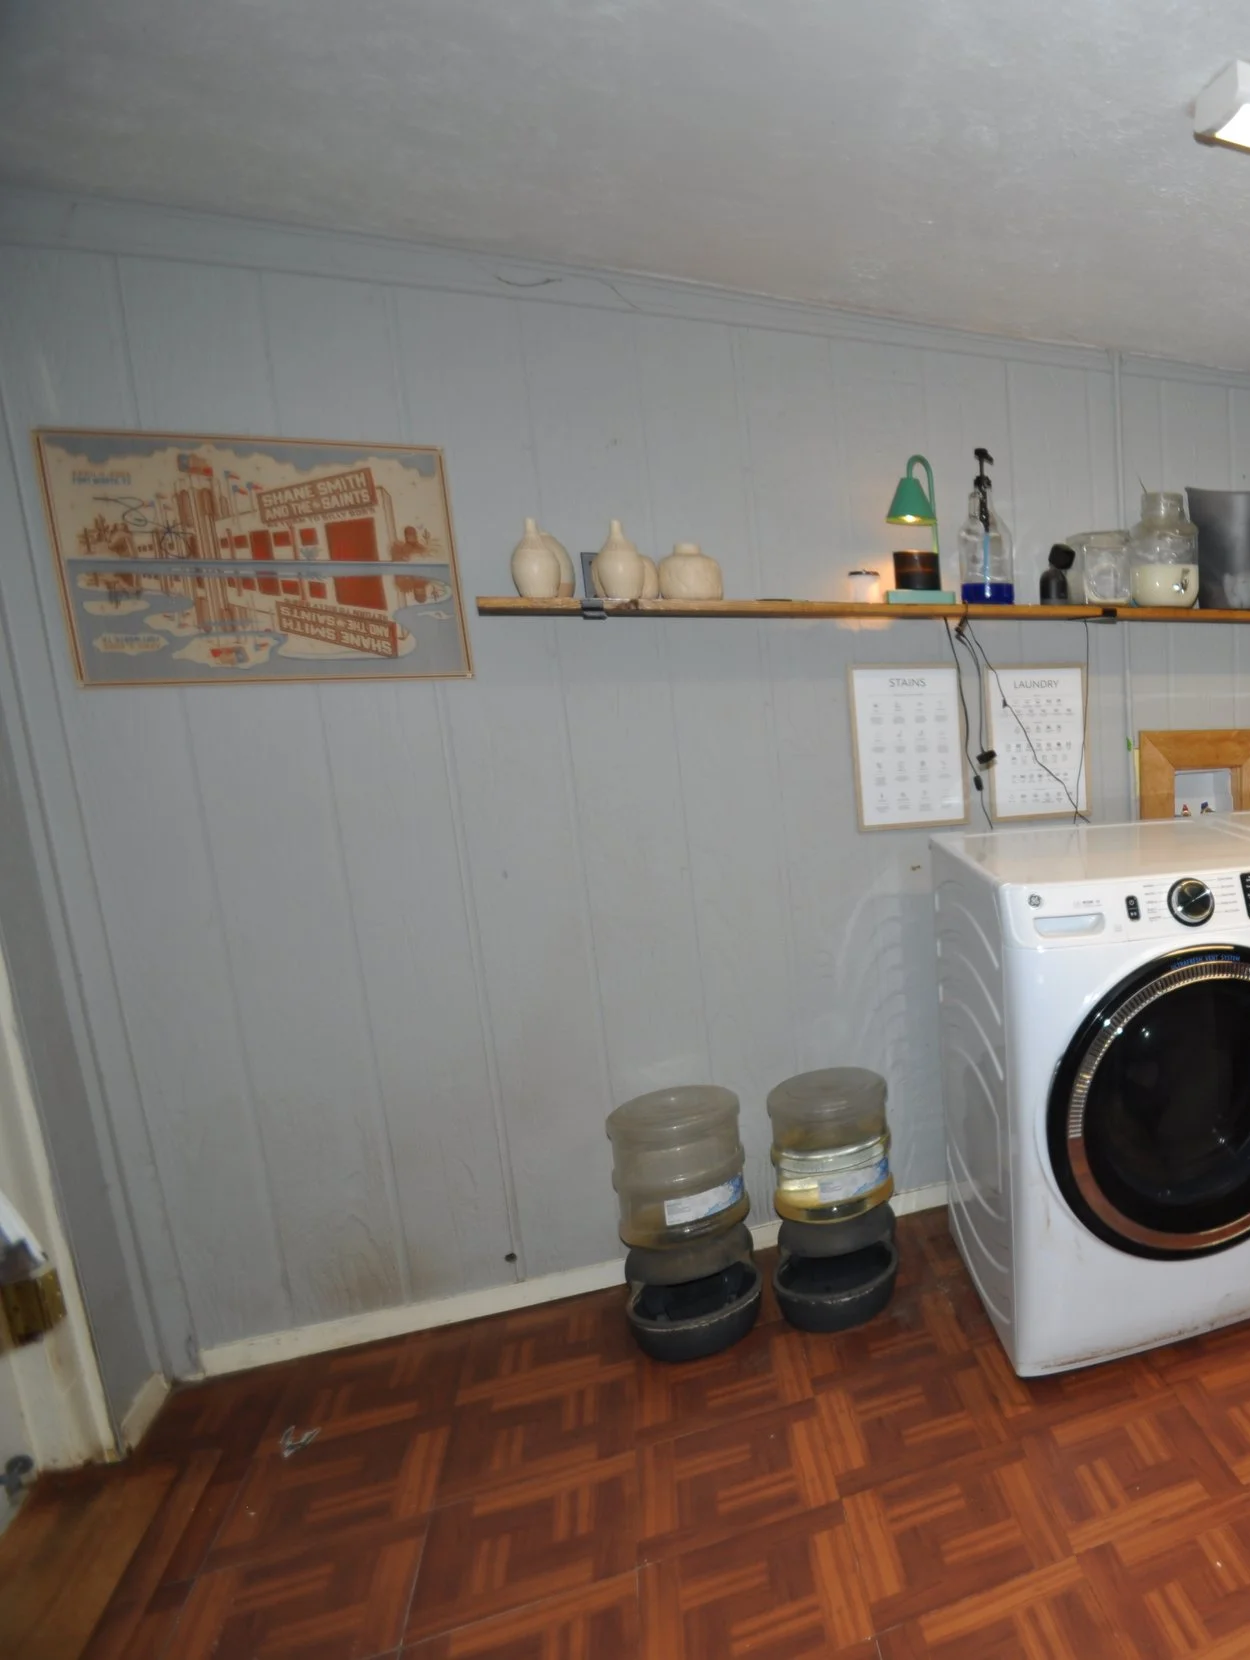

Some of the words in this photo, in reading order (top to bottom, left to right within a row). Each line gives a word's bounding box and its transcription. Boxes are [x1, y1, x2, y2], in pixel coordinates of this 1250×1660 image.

[263, 484, 315, 507] SHANE
[316, 472, 368, 496] SMITH
[265, 505, 290, 521] AND
[320, 489, 370, 509] SAINTS
[279, 605, 336, 627] SAINTS
[281, 618, 337, 641] SMITH
[340, 631, 393, 655] SHANE
[889, 678, 926, 688] STAINS
[1013, 679, 1059, 689] LAUNDRY
